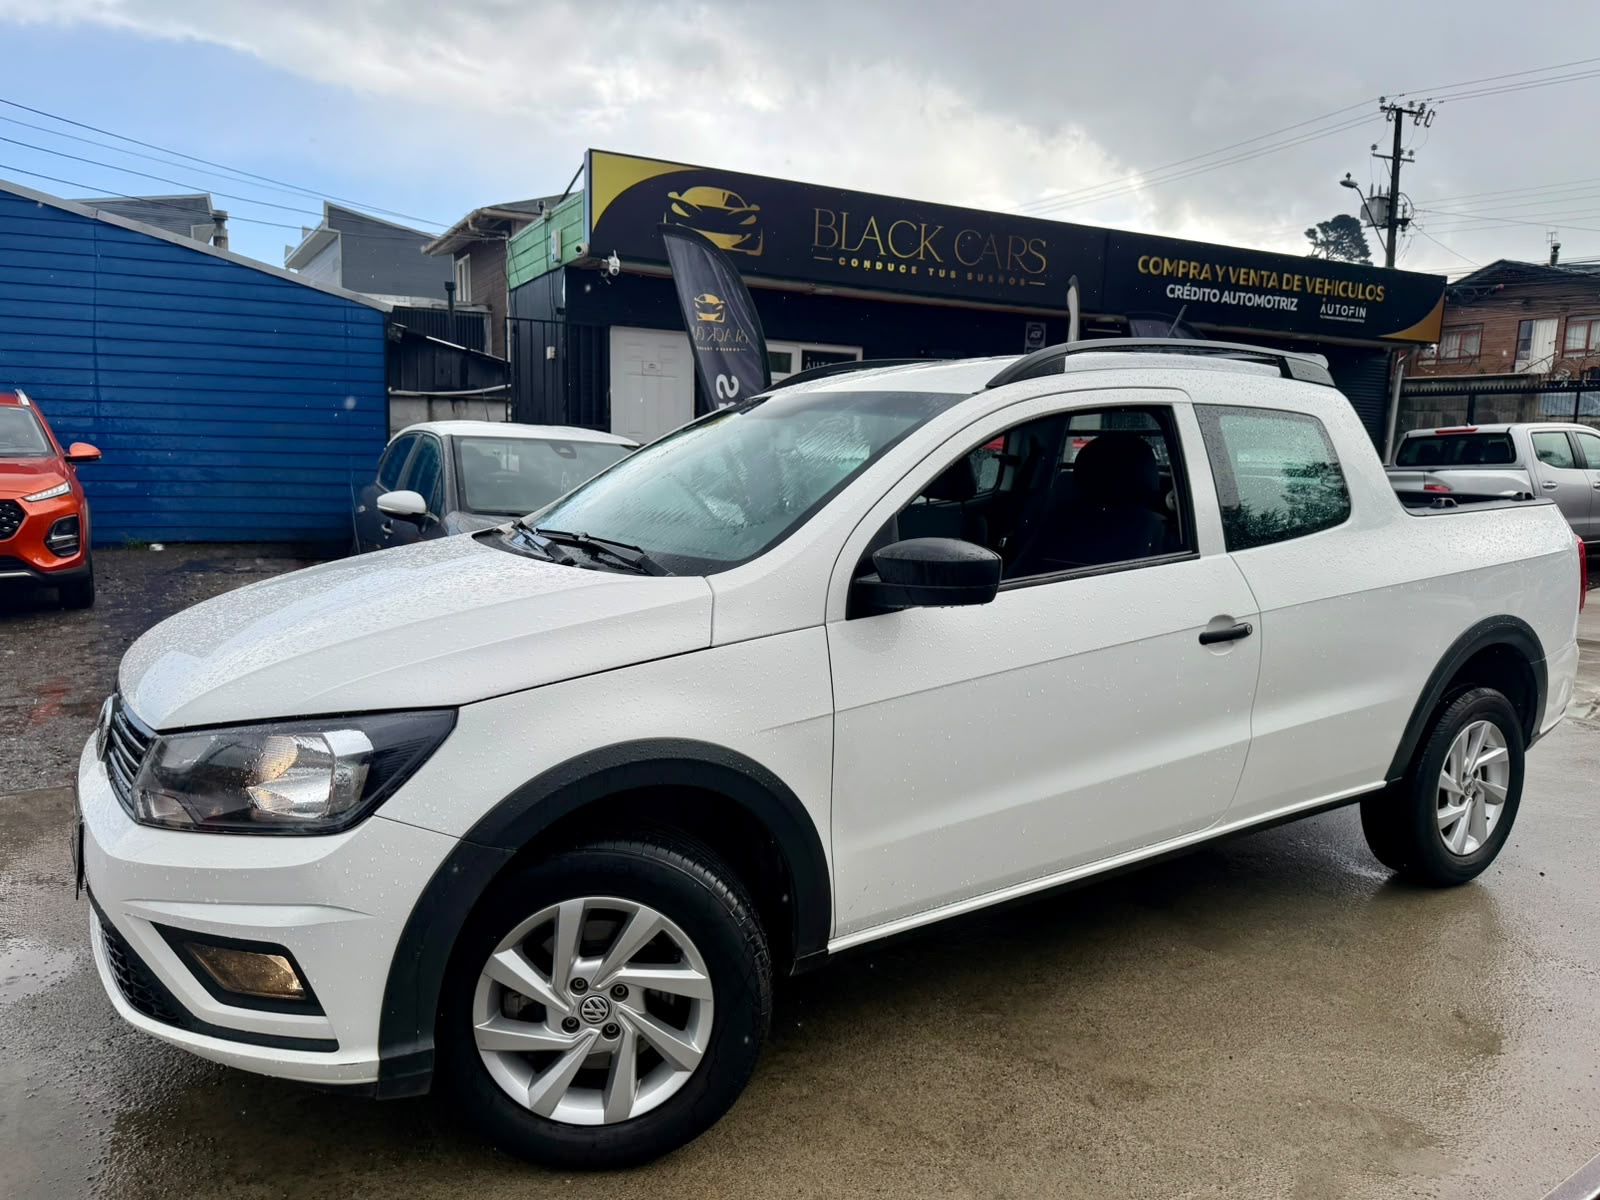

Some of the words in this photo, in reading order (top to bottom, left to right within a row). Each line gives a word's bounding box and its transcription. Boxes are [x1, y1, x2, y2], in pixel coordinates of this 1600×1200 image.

[811, 207, 945, 263] BLACK
[954, 229, 1048, 274] CARS
[838, 256, 917, 275] CONDUCE
[928, 267, 957, 279] TUS
[1137, 255, 1212, 281] COMPRA
[1215, 264, 1226, 282] Y
[1228, 266, 1280, 289] VENTA
[1281, 273, 1302, 292] DE
[1305, 275, 1386, 302] VEHICULOS
[1166, 282, 1220, 303] CRÉDITO
[1220, 290, 1299, 311] AUTOMOTRIZ
[1319, 302, 1367, 318] AUTOFIN
